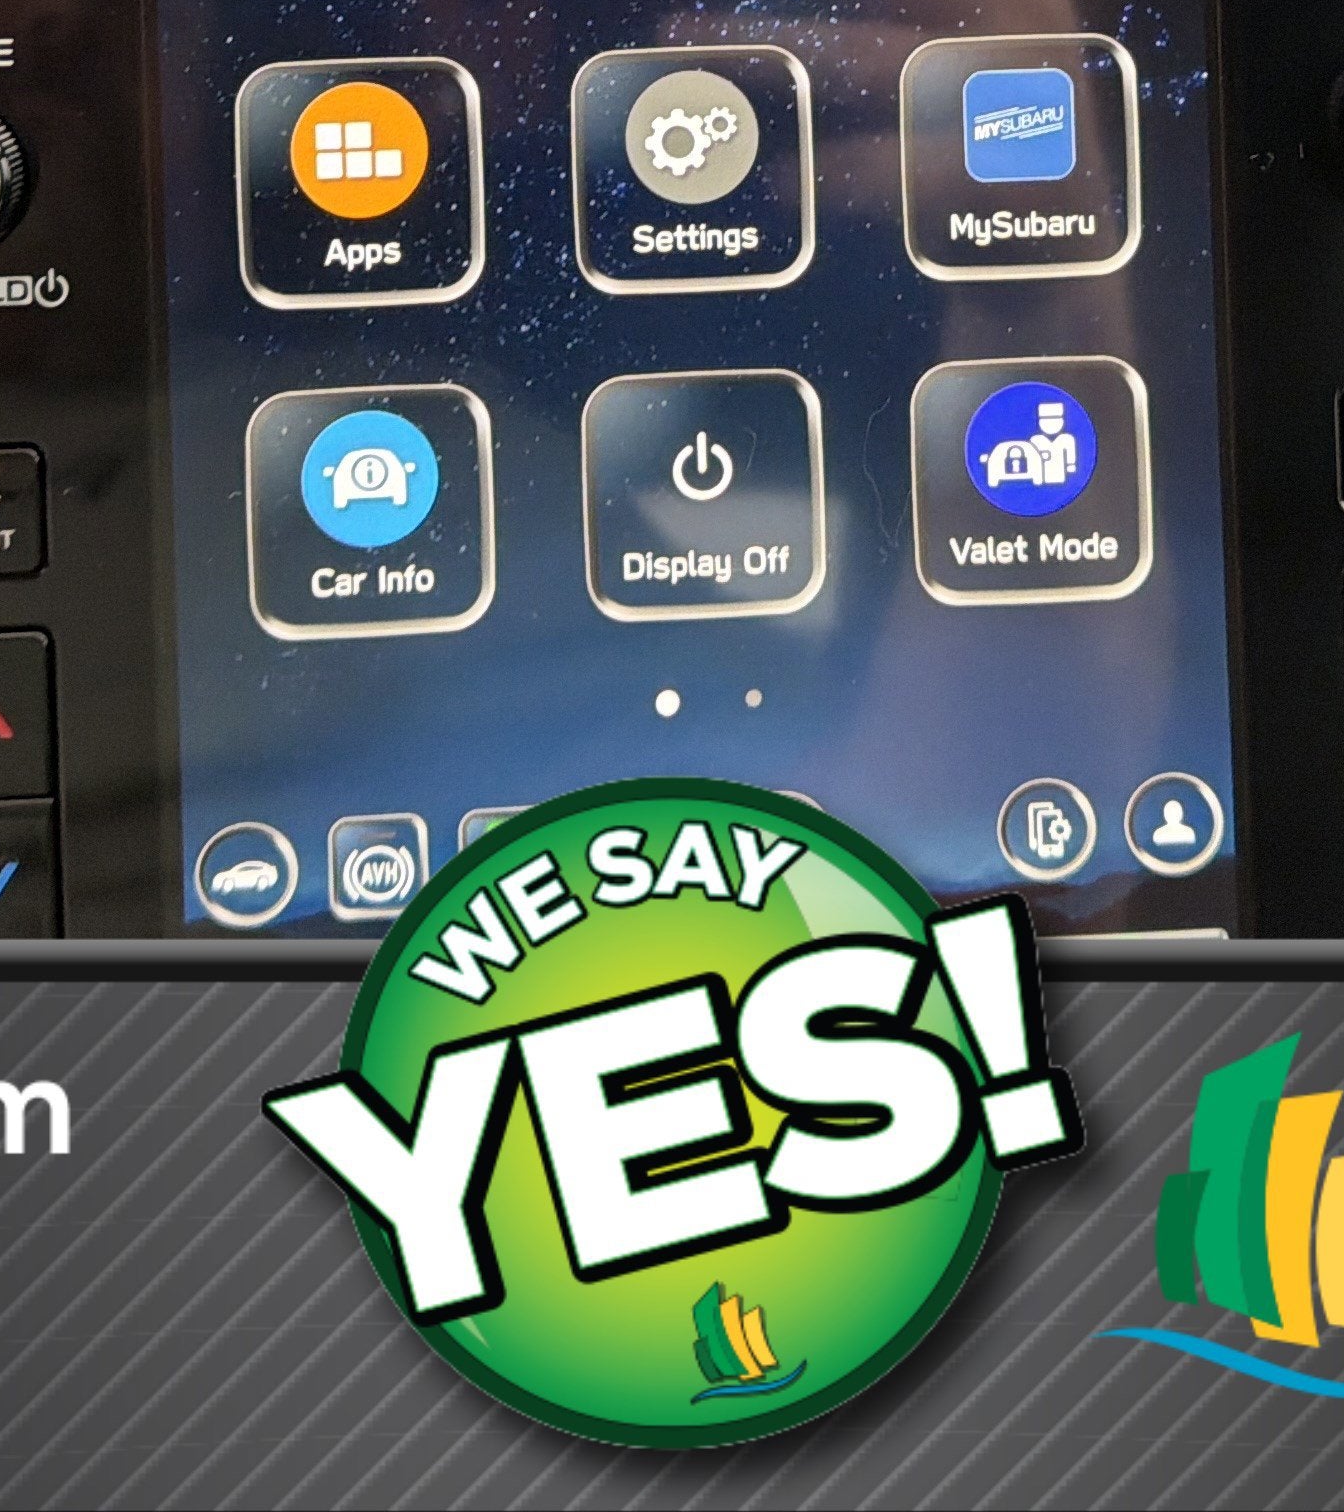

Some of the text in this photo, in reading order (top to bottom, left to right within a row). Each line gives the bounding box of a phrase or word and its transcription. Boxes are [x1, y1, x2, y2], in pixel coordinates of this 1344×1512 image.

[974, 104, 1064, 141] MYSUBARU
[632, 223, 759, 257] Settings
[950, 210, 1096, 246] MySubaru
[324, 238, 402, 272] Apps
[622, 544, 790, 585] Display Off
[949, 531, 1119, 565] Valet Mode
[311, 563, 435, 598] Car Info
[360, 861, 398, 888] AVH
